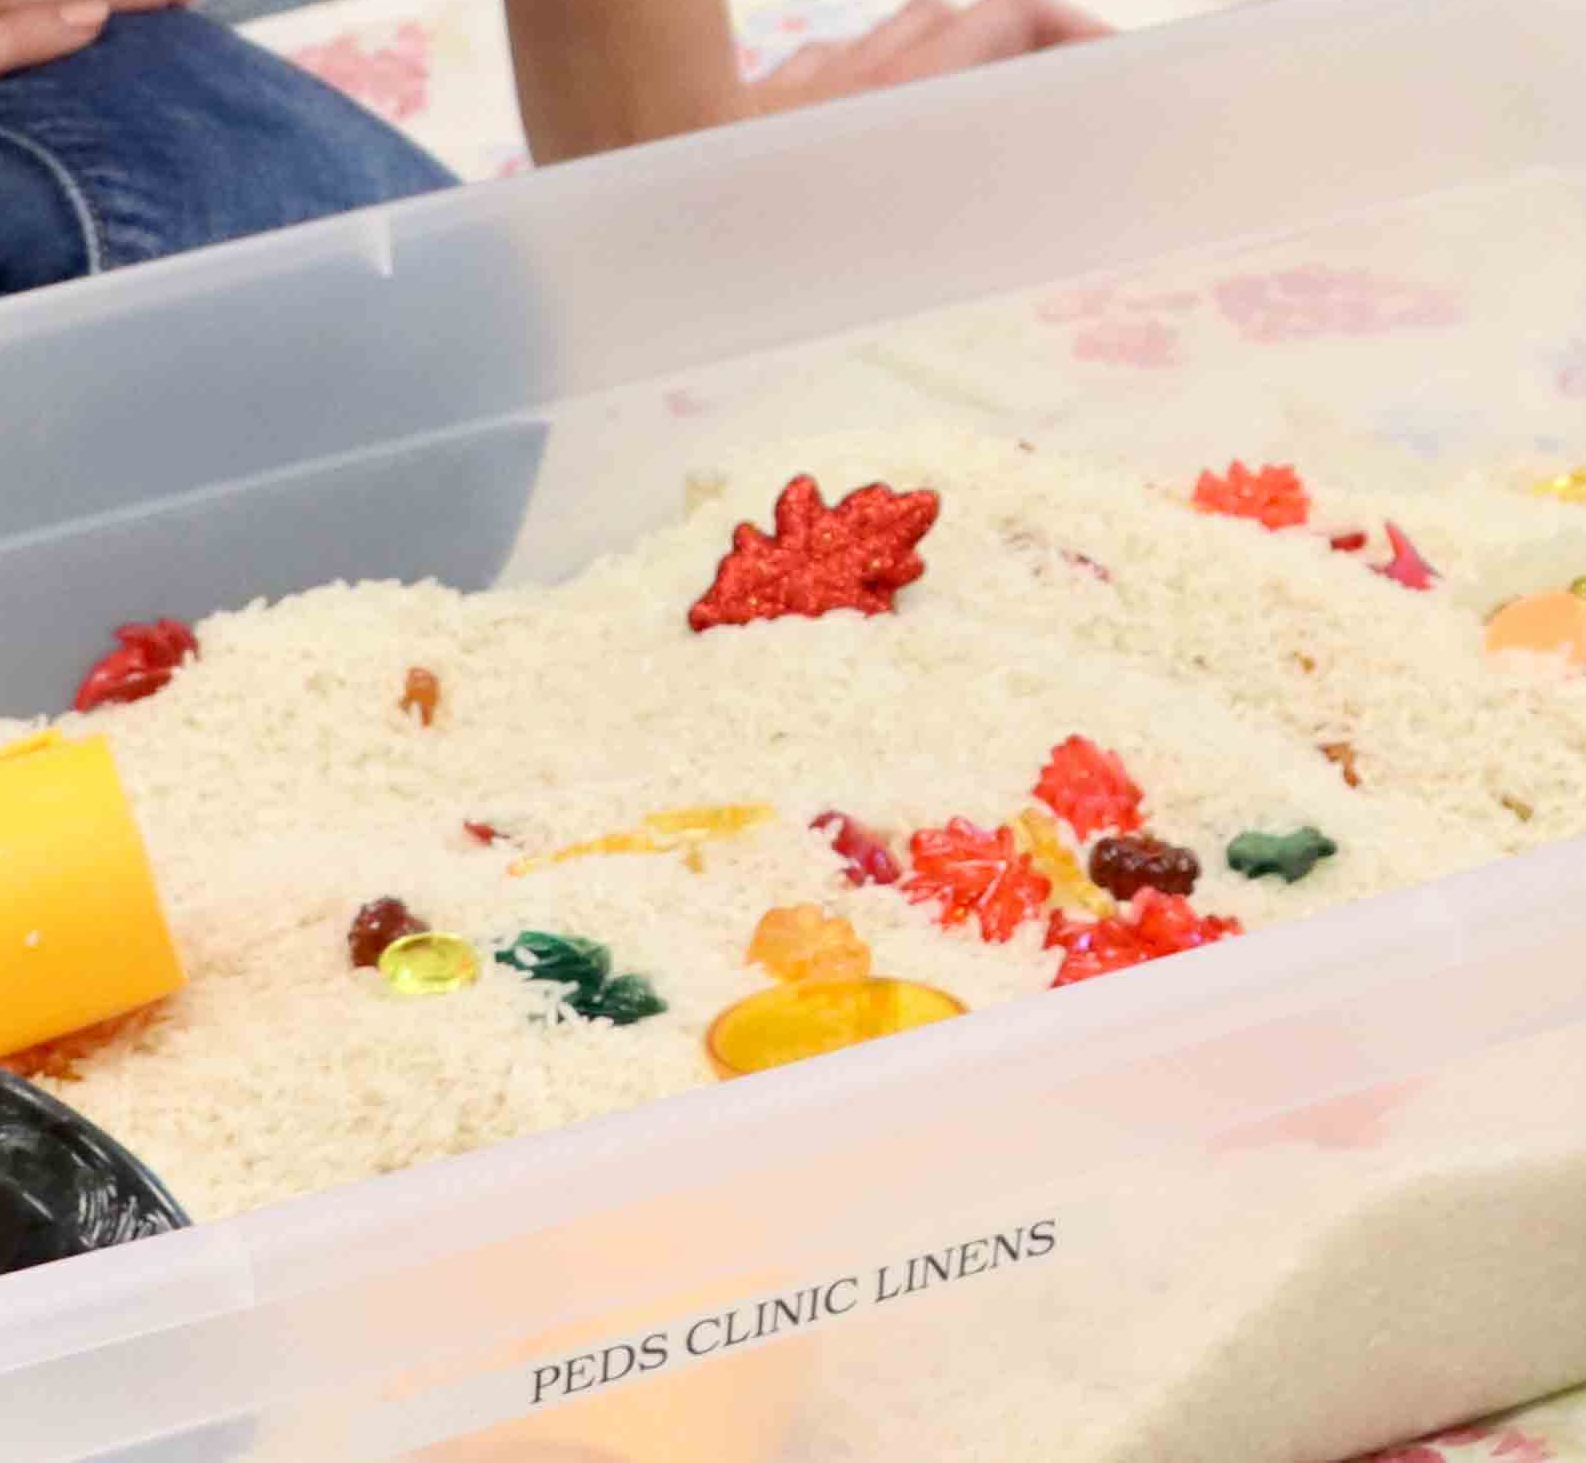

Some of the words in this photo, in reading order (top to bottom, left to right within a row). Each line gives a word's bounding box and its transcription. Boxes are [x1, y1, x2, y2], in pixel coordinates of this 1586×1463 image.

[530, 1333, 669, 1405] PEDS
[685, 1277, 859, 1356] CLINIC
[874, 1219, 1057, 1305] LINENS
